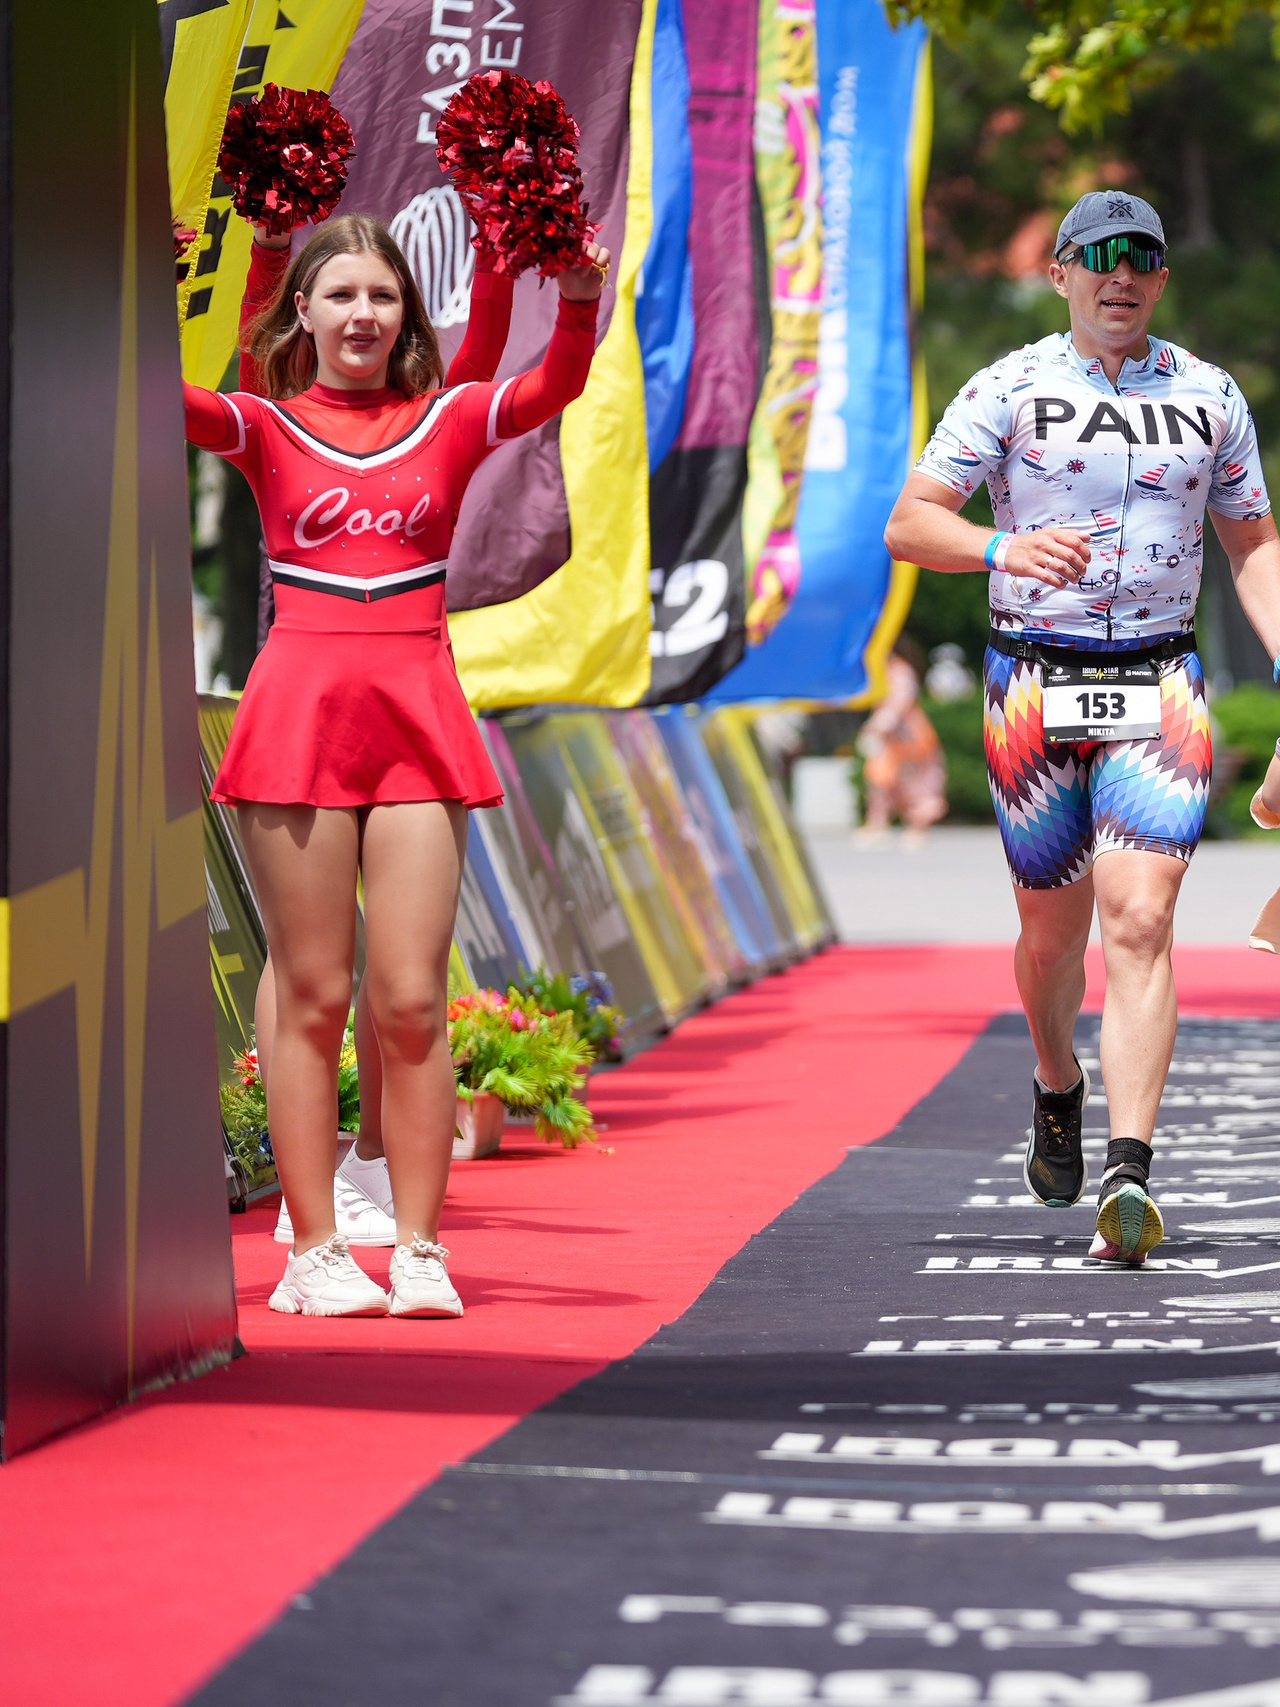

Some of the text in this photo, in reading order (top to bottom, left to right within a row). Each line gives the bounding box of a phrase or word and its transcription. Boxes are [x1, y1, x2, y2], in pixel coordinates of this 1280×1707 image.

[1034, 398, 1213, 446] PAIN
[294, 487, 430, 548] Cool
[1076, 693, 1126, 719] 153
[1088, 728, 1115, 736] NIKITA
[924, 1256, 1220, 1270] IRON
[862, 1338, 1205, 1352] IRON
[772, 1431, 1182, 1459] IRON
[714, 1491, 1166, 1527] IRON
[572, 1663, 1149, 1707] IRON
